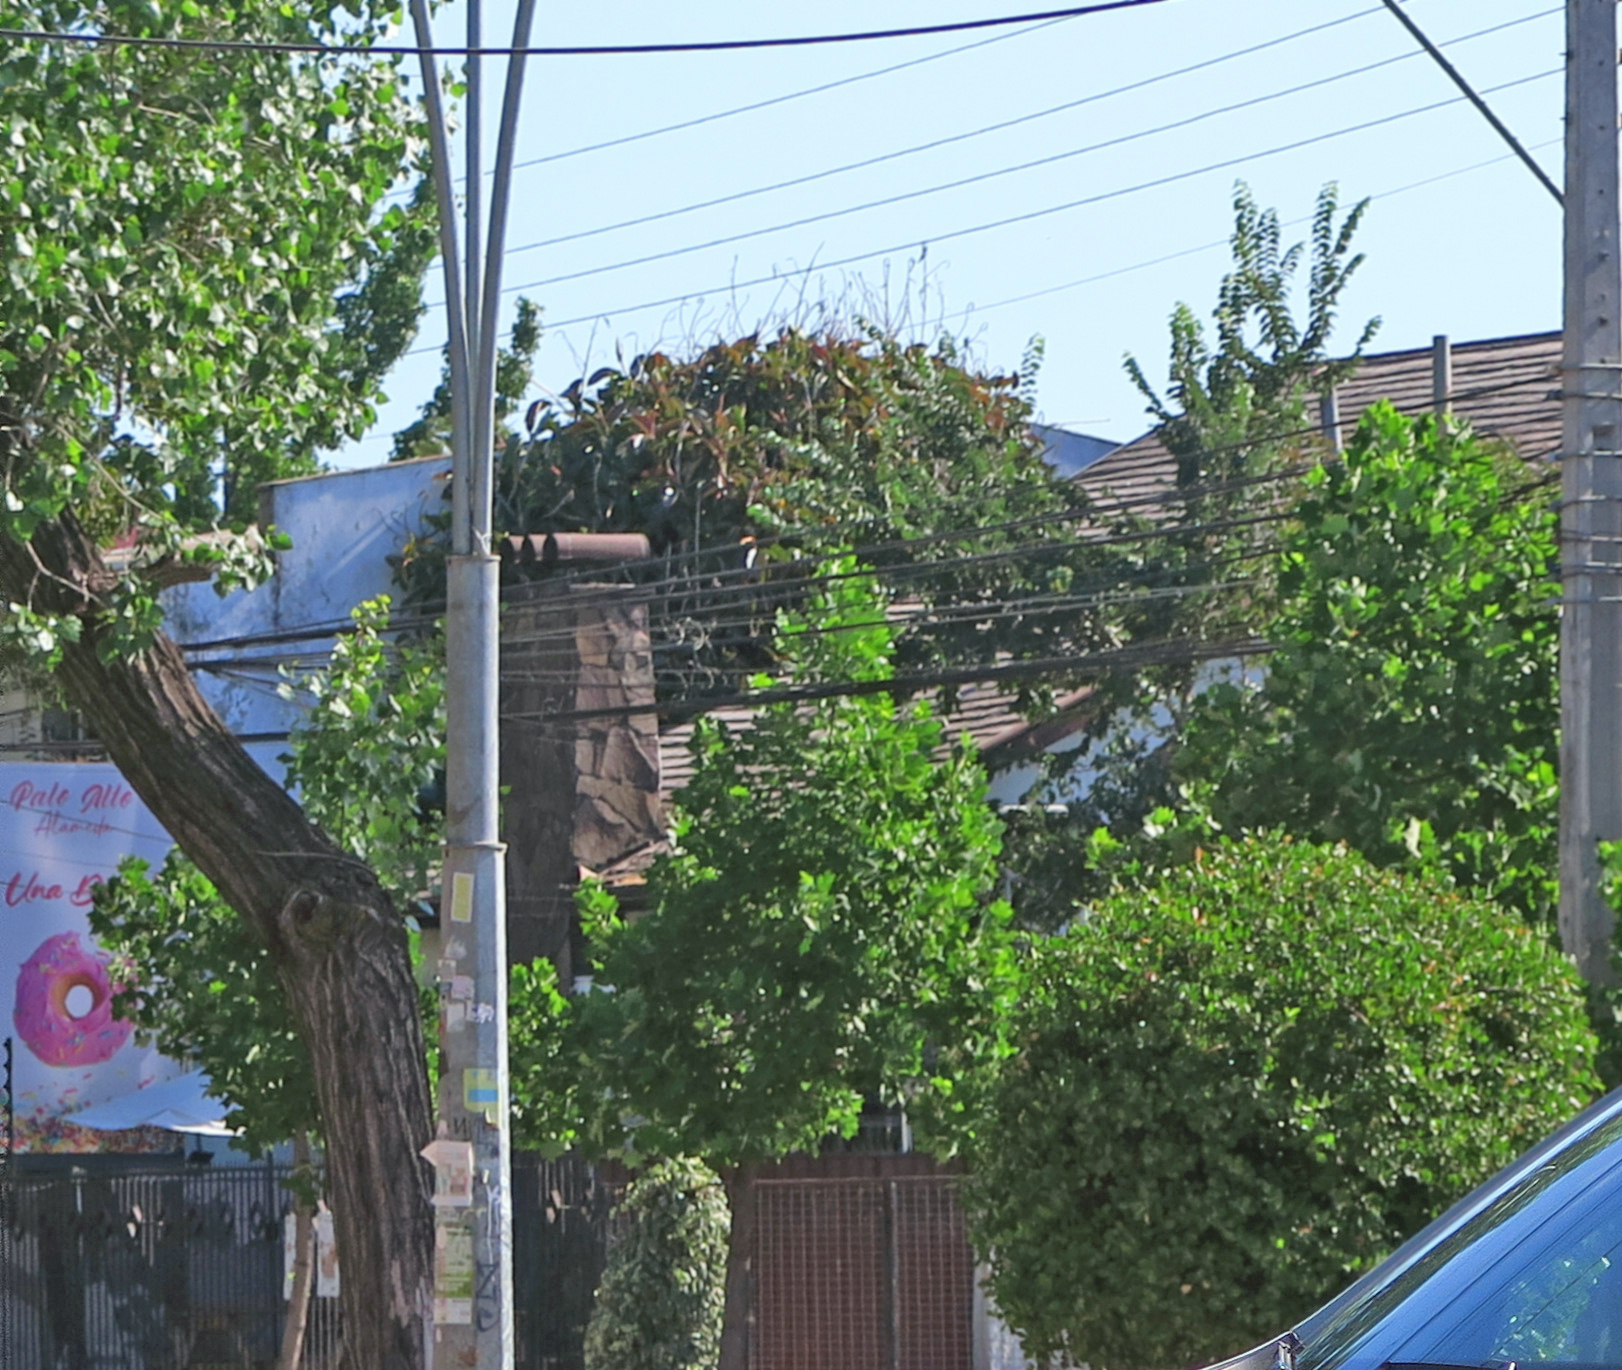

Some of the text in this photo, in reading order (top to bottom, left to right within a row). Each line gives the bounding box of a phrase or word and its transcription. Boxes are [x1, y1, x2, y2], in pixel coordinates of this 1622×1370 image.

[10, 780, 133, 814] Palo Alto
[5, 871, 63, 907] Una
